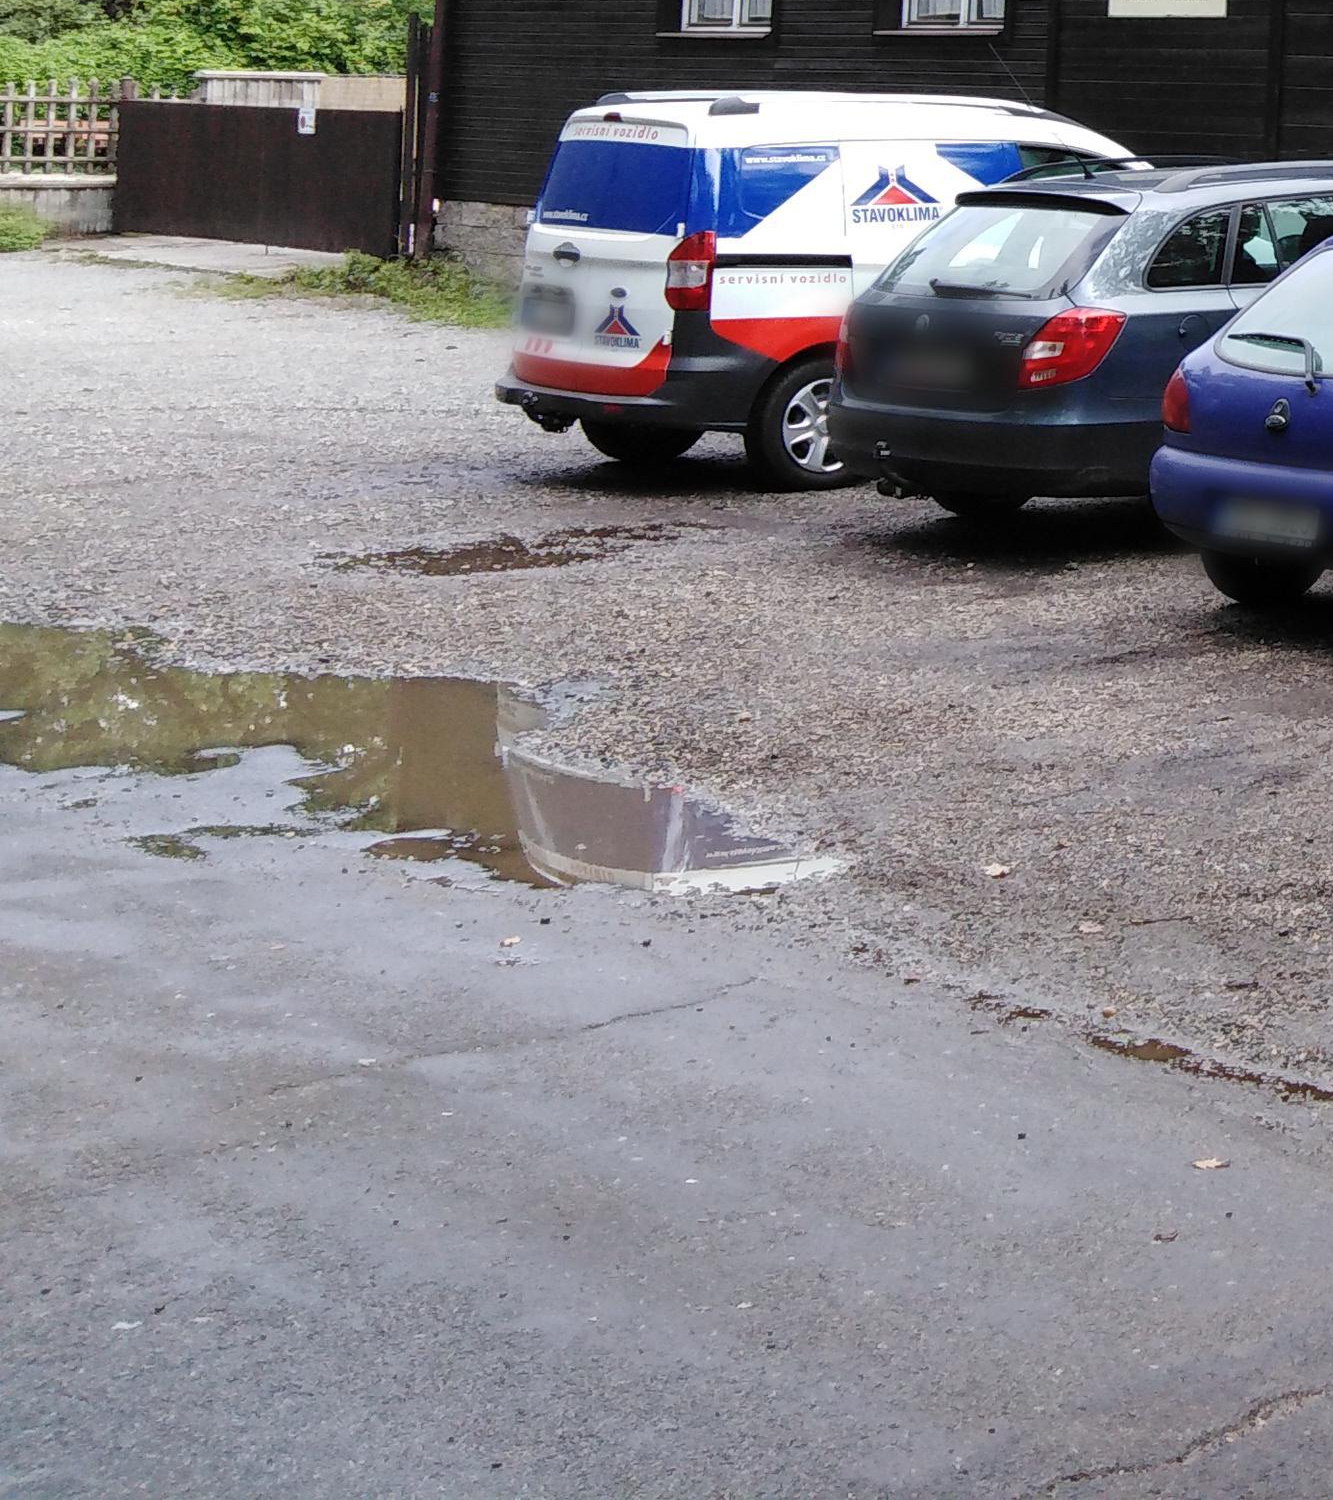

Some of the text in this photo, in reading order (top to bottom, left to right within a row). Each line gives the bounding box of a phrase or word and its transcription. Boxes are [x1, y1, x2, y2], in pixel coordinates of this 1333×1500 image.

[613, 125, 660, 140] vozidlo
[852, 206, 940, 223] STAVOKLIMA
[719, 272, 847, 285] servisní vozidlo
[594, 335, 640, 349] STAVOKLIMA
